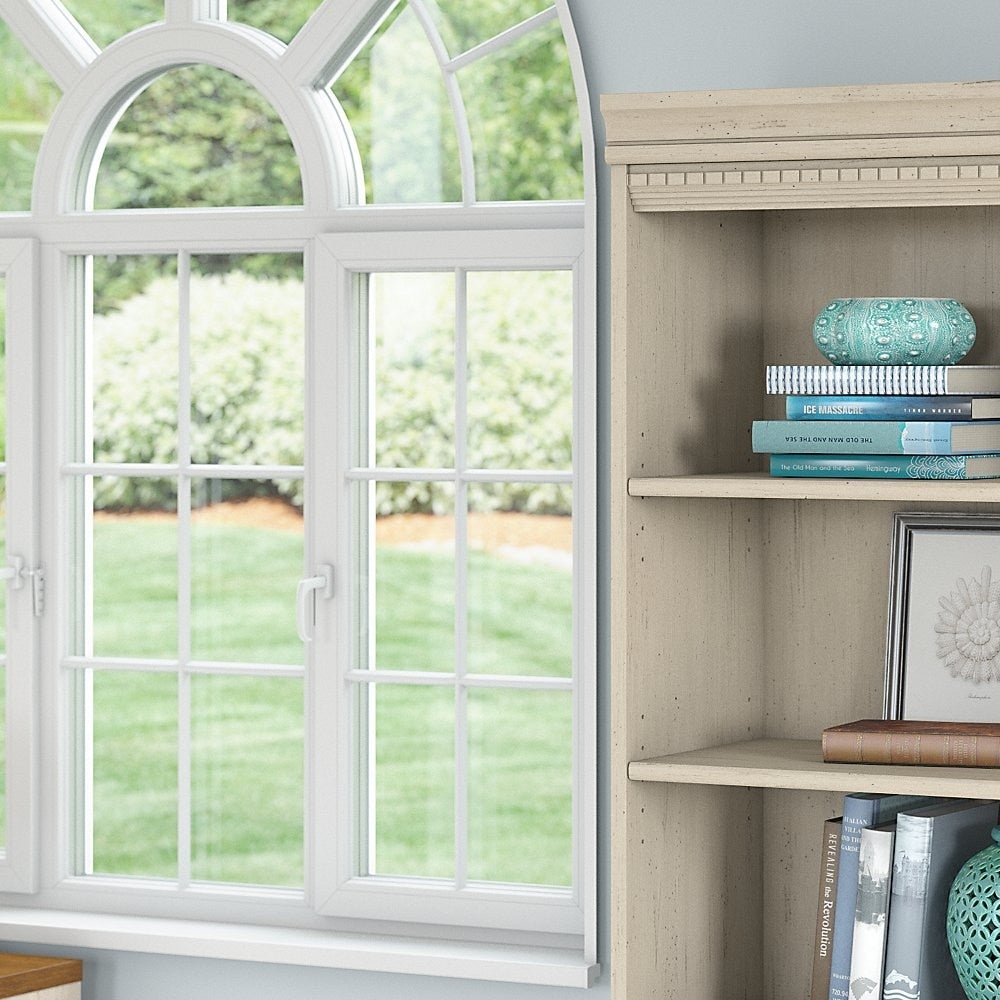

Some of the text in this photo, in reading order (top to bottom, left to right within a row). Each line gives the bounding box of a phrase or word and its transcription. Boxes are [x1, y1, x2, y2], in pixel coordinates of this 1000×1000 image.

[803, 405, 863, 415] ICE MASSACRE
[866, 464, 901, 473] Hemingway
[844, 825, 861, 834] VILLA
[820, 833, 838, 957] REVEALING the Revolution
